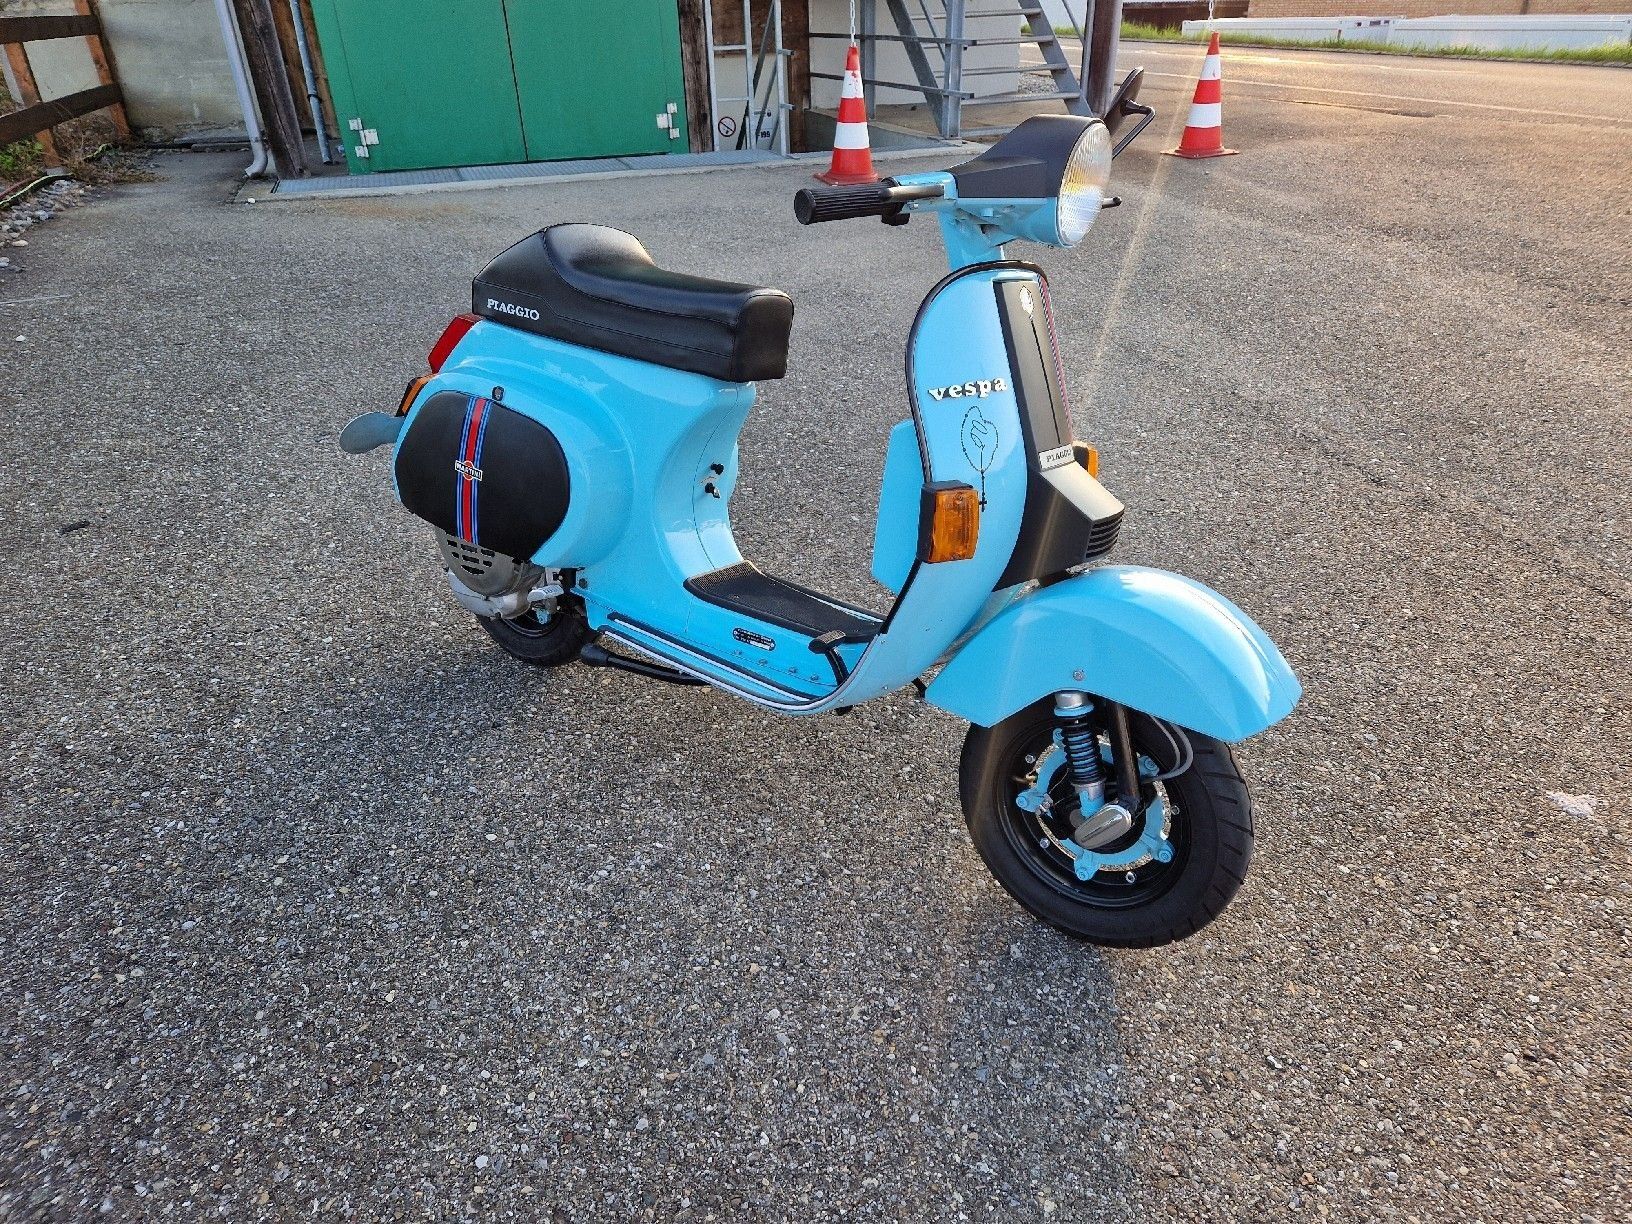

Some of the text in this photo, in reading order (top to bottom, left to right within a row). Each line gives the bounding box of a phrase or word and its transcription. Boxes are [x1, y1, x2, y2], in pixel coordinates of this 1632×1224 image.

[486, 298, 540, 321] PIAGGIO
[927, 377, 1008, 401] vespa
[455, 462, 482, 478] MARTINI
